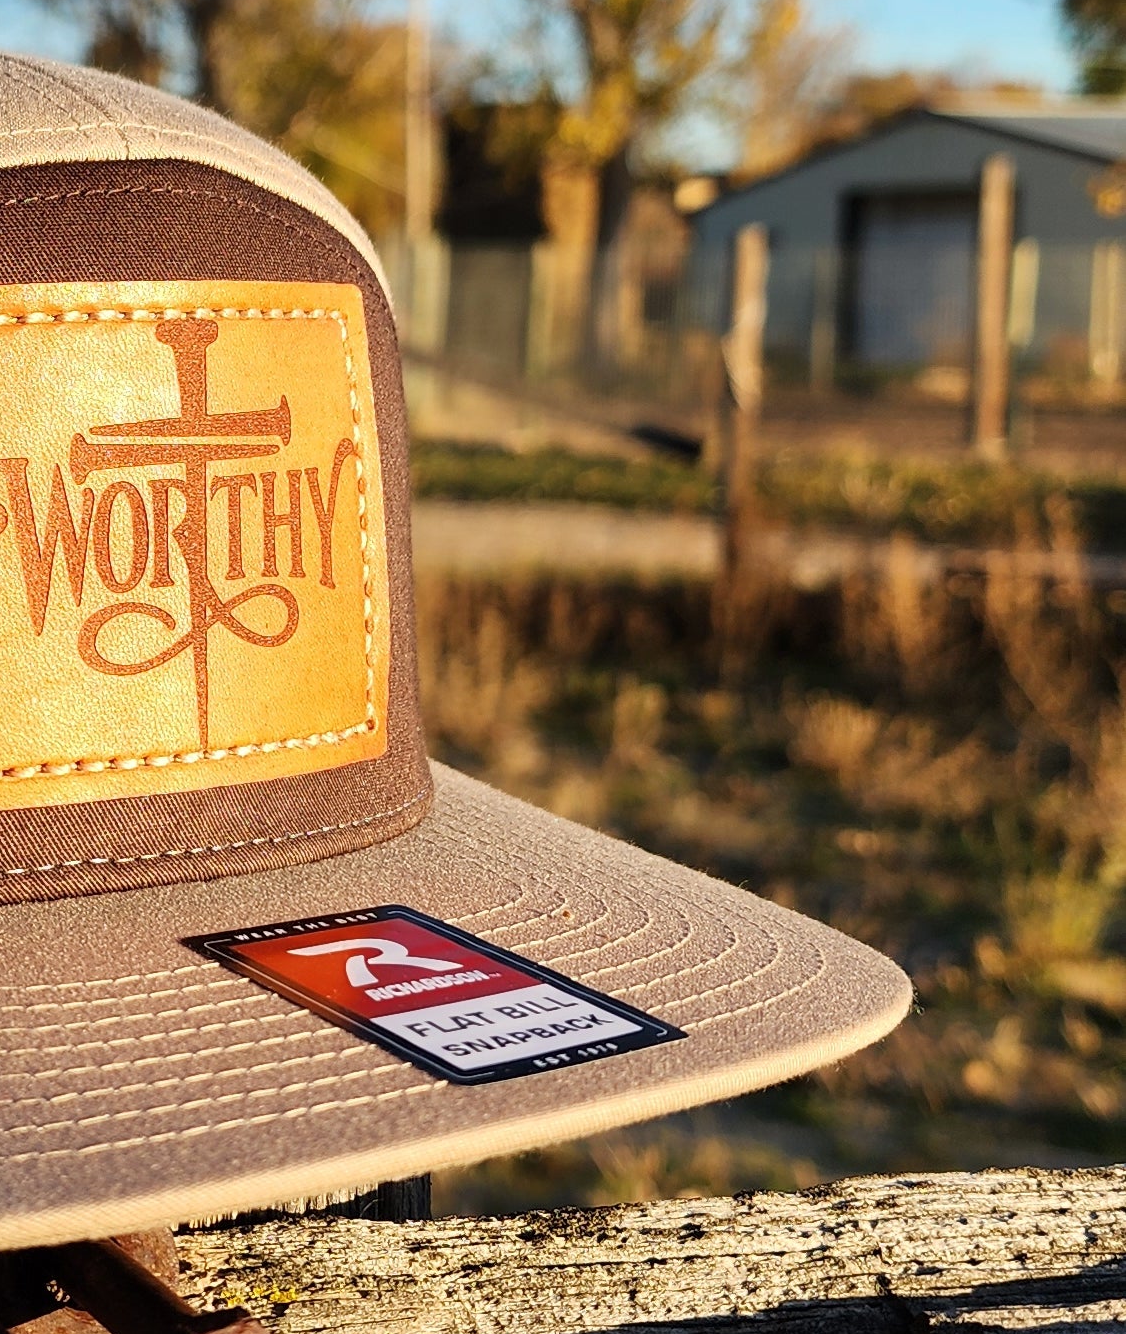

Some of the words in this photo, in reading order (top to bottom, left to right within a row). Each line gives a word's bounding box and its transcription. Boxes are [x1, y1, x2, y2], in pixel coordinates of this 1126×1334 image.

[233, 928, 288, 941] WEAR
[292, 921, 330, 932] THE
[334, 912, 378, 925] BEST
[403, 1011, 496, 1038] FLAT
[494, 996, 579, 1019] BILL
[441, 1013, 614, 1056] SNAPBACK
[532, 1053, 571, 1068] EST
